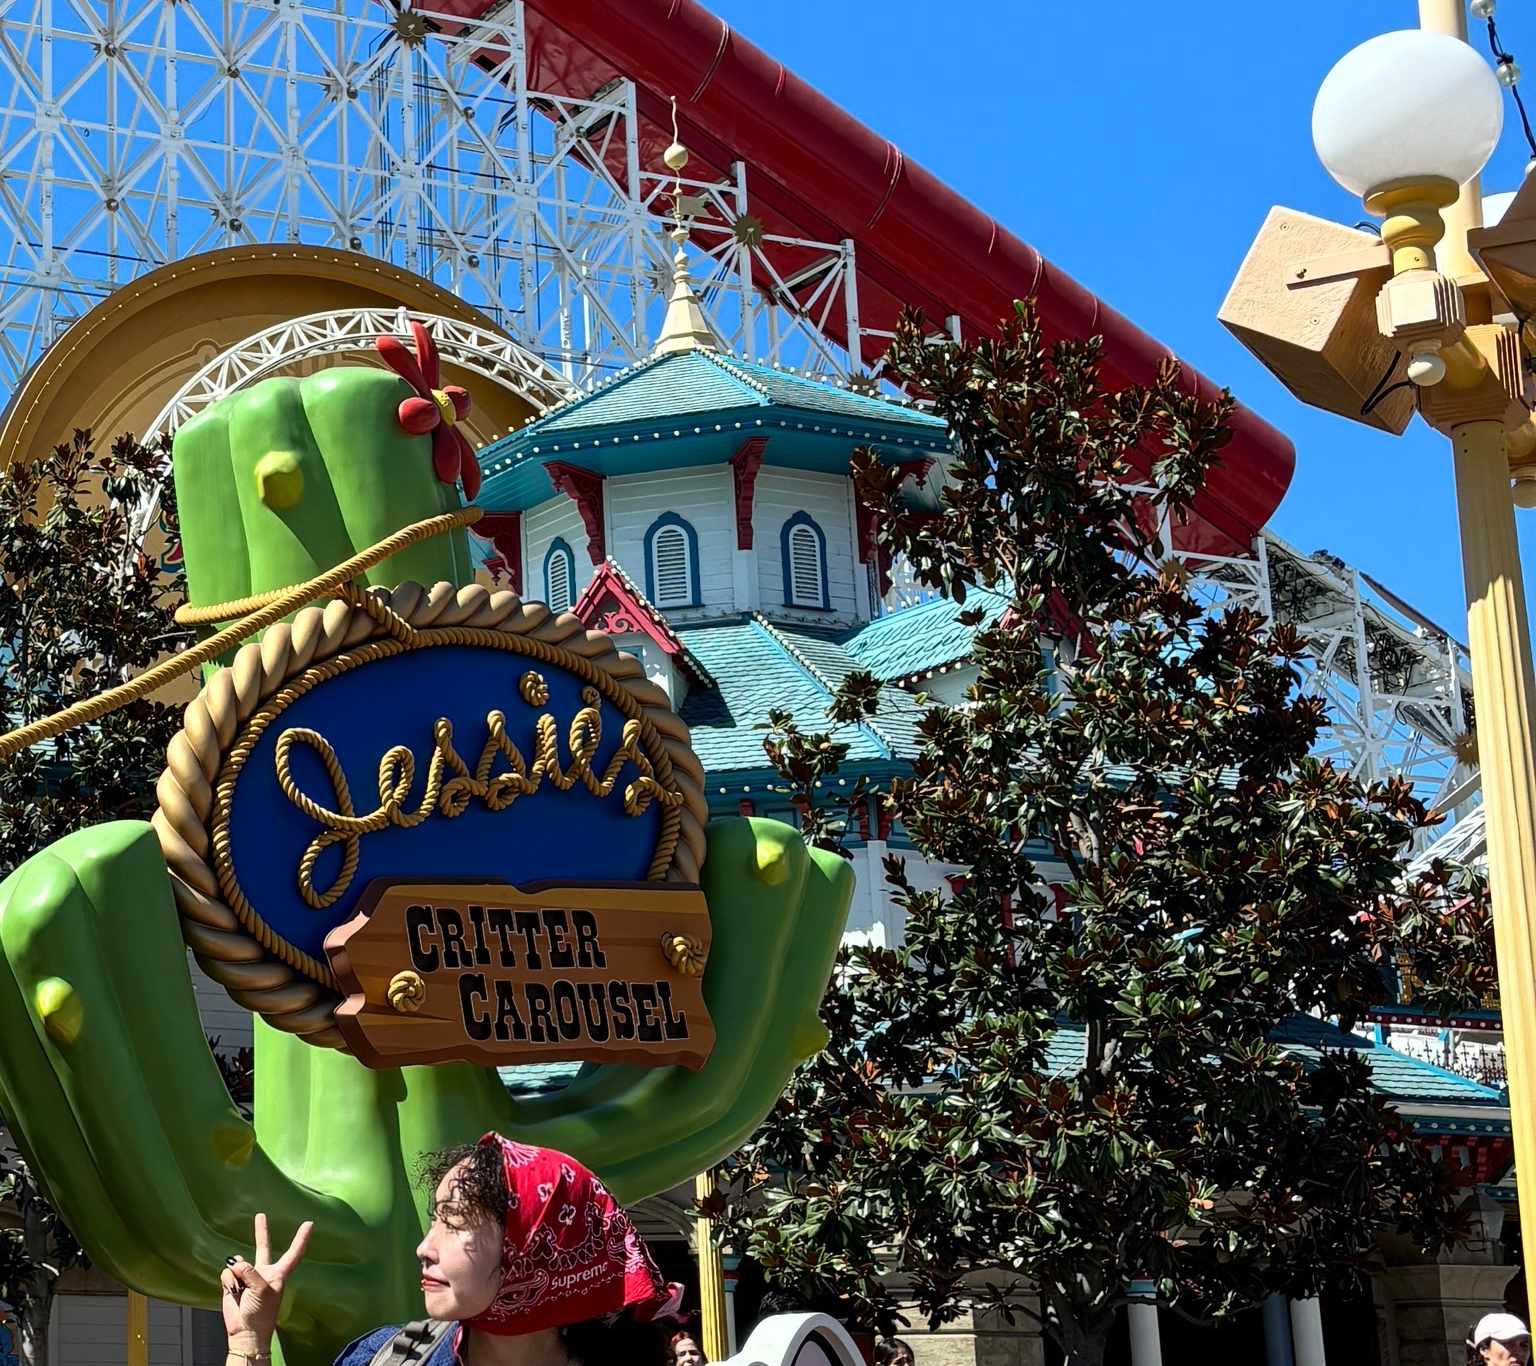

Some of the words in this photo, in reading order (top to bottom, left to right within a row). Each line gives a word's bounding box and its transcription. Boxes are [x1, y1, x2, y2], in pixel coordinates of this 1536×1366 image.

[275, 670, 684, 909] Jessie's
[405, 904, 608, 973] CRITTER
[458, 972, 690, 1044] CAROUSEL
